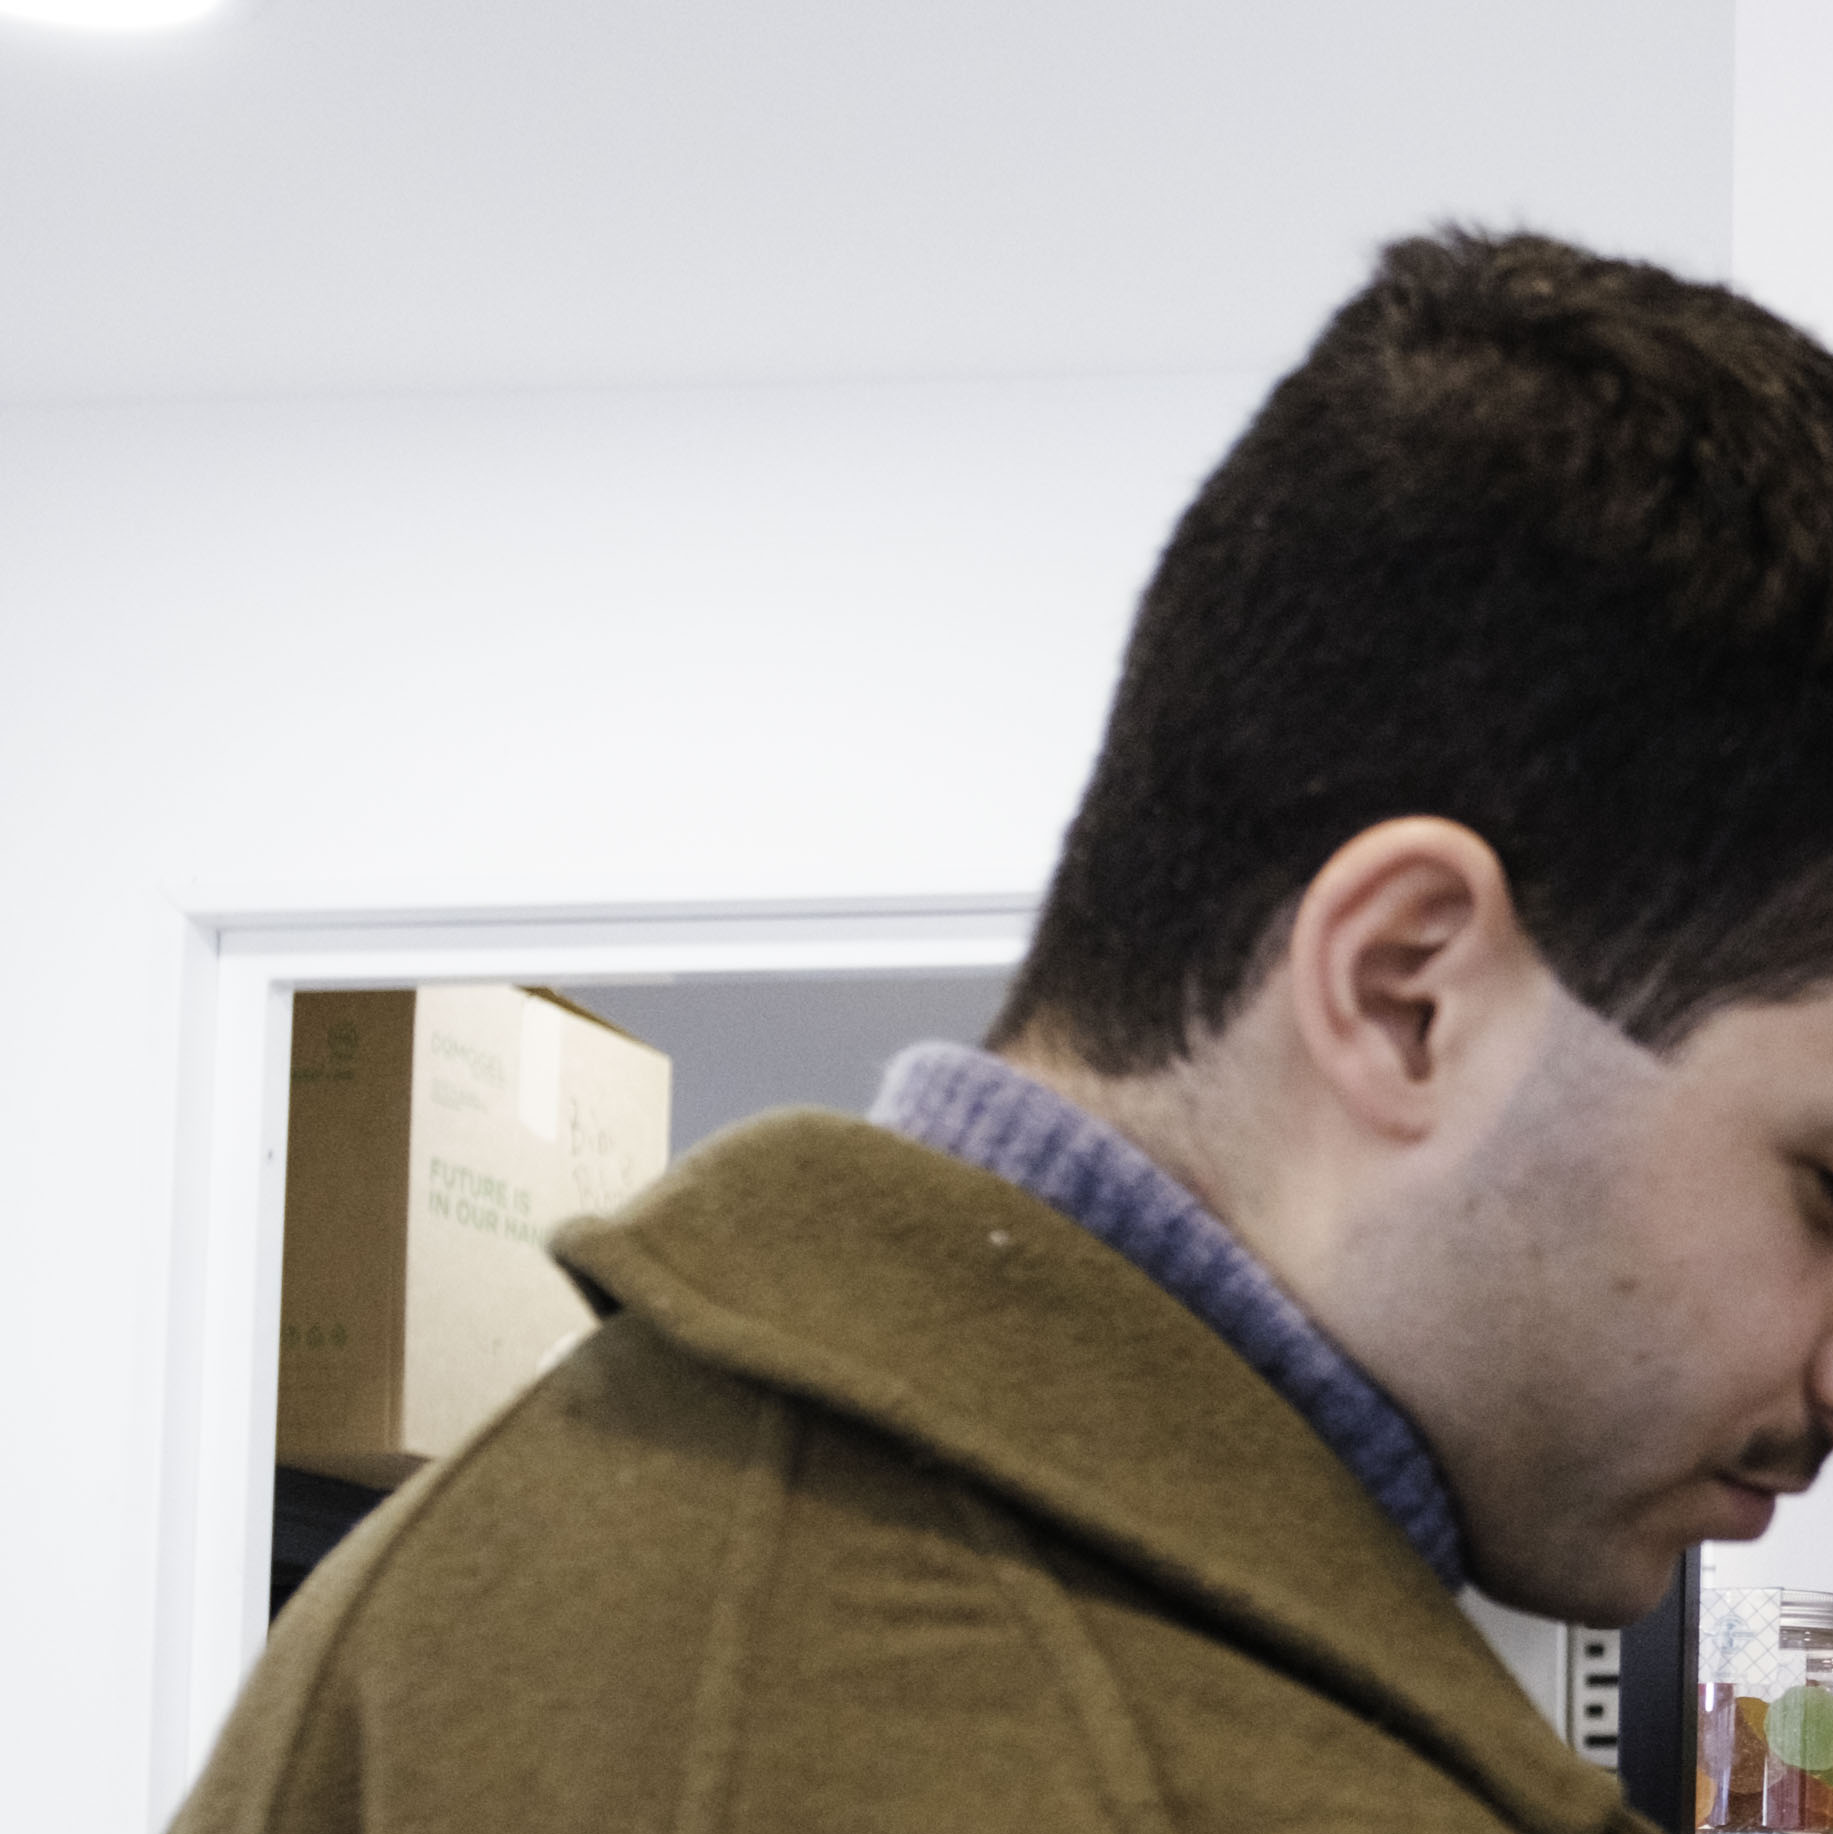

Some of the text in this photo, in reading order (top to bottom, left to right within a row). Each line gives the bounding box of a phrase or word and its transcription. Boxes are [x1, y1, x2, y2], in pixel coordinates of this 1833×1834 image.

[429, 1155, 532, 1217] FUTURE IS
[428, 1190, 550, 1250] IN OUR HAN
